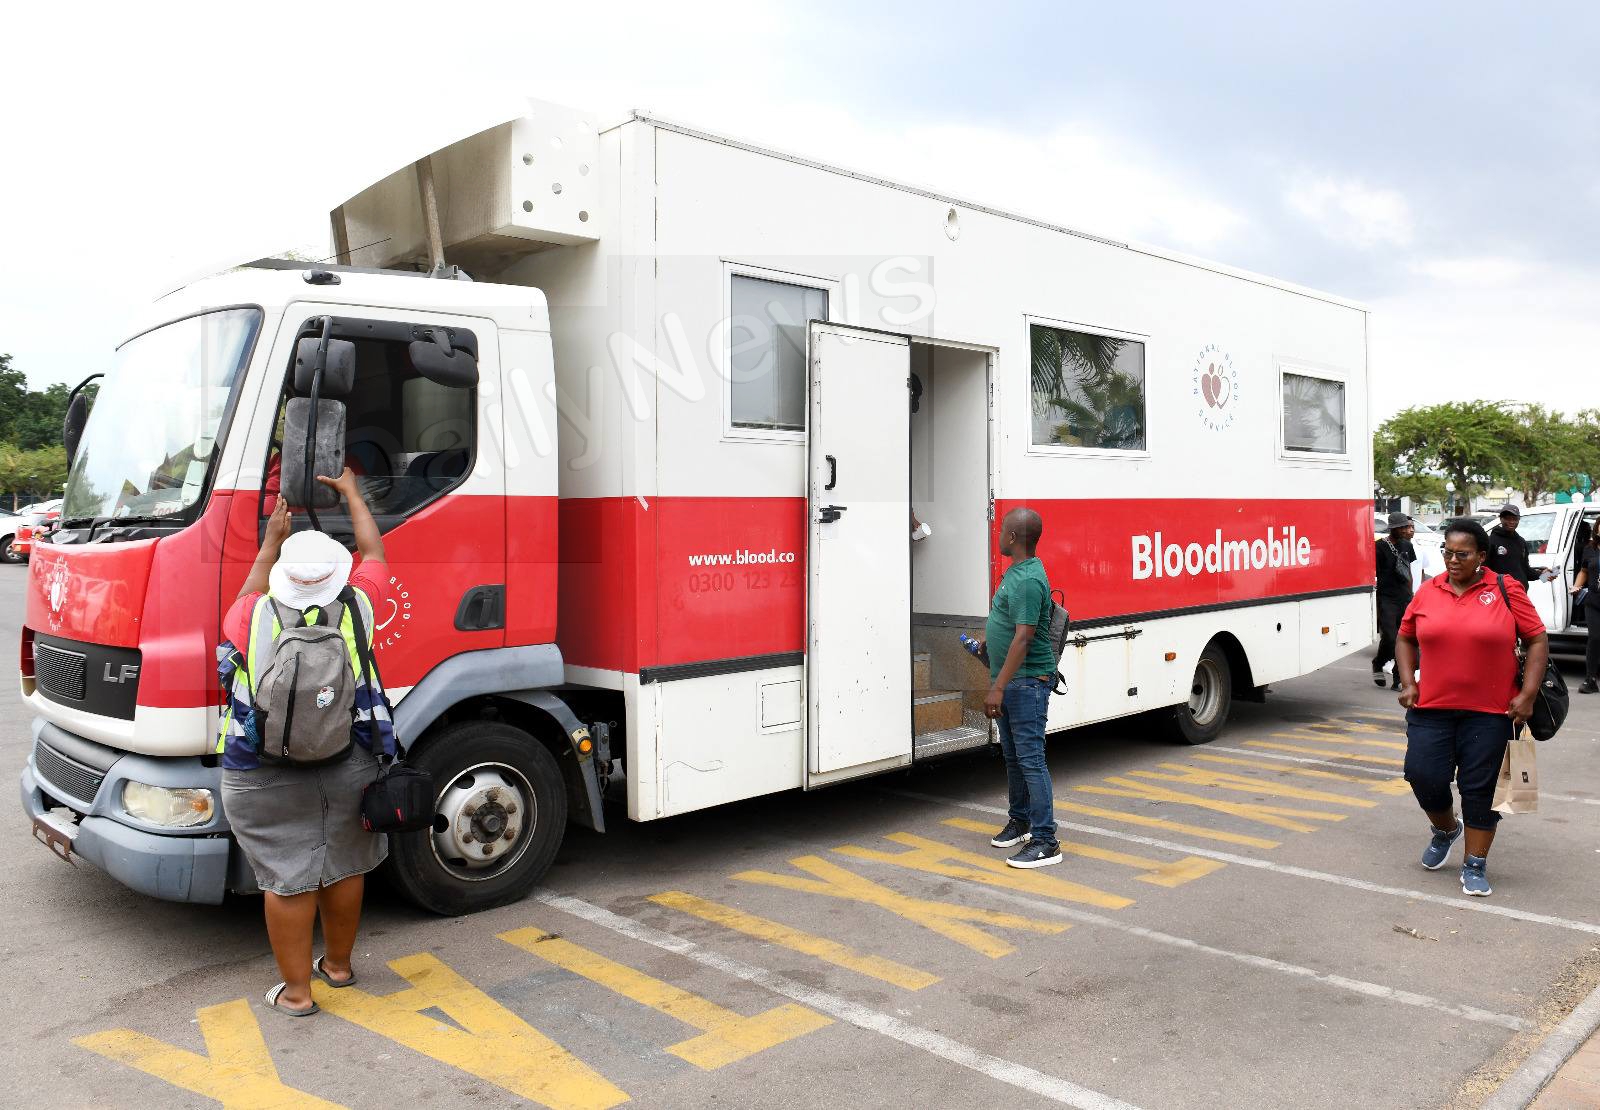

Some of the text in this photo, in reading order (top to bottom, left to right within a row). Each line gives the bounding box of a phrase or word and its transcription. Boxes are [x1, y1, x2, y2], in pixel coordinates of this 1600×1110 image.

[1193, 343, 1239, 401] NATIONAL BLOOD
[1199, 409, 1234, 432] SERVICE
[688, 549, 795, 566] www.blood.co
[1131, 525, 1311, 580] Bloodmobile
[389, 576, 411, 620] BLOOD
[688, 572, 735, 593] 0300
[743, 570, 770, 590] 123
[103, 662, 139, 684] LF
[645, 816, 1227, 991] TAXI
